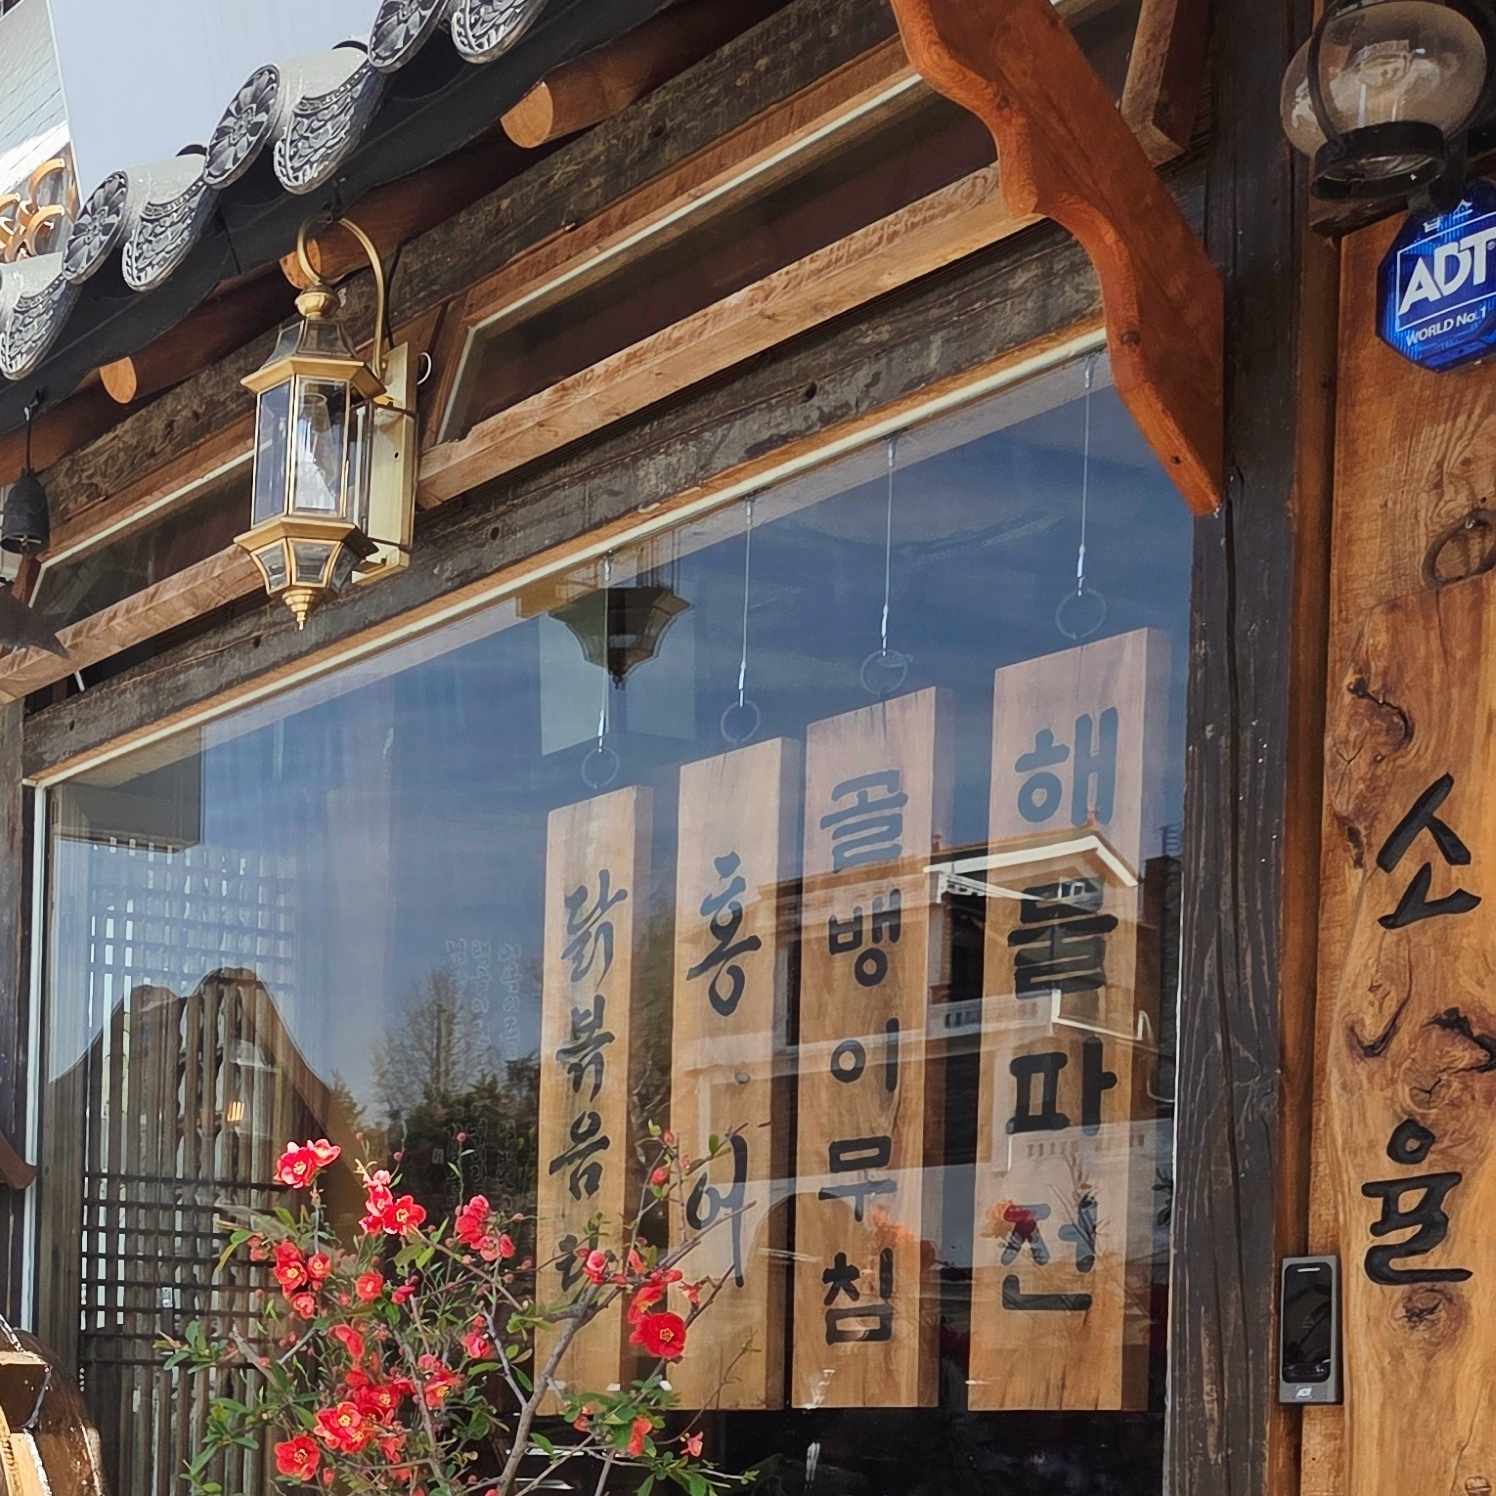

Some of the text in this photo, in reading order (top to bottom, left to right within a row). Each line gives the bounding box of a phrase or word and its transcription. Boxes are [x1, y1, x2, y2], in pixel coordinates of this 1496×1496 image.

[1398, 226, 1496, 316] ADT
[1405, 305, 1487, 347] WORLD No.1
[685, 851, 761, 1288] 홍어
[818, 768, 909, 1346] 골뱅이무침
[1002, 705, 1118, 1313] 해물파전
